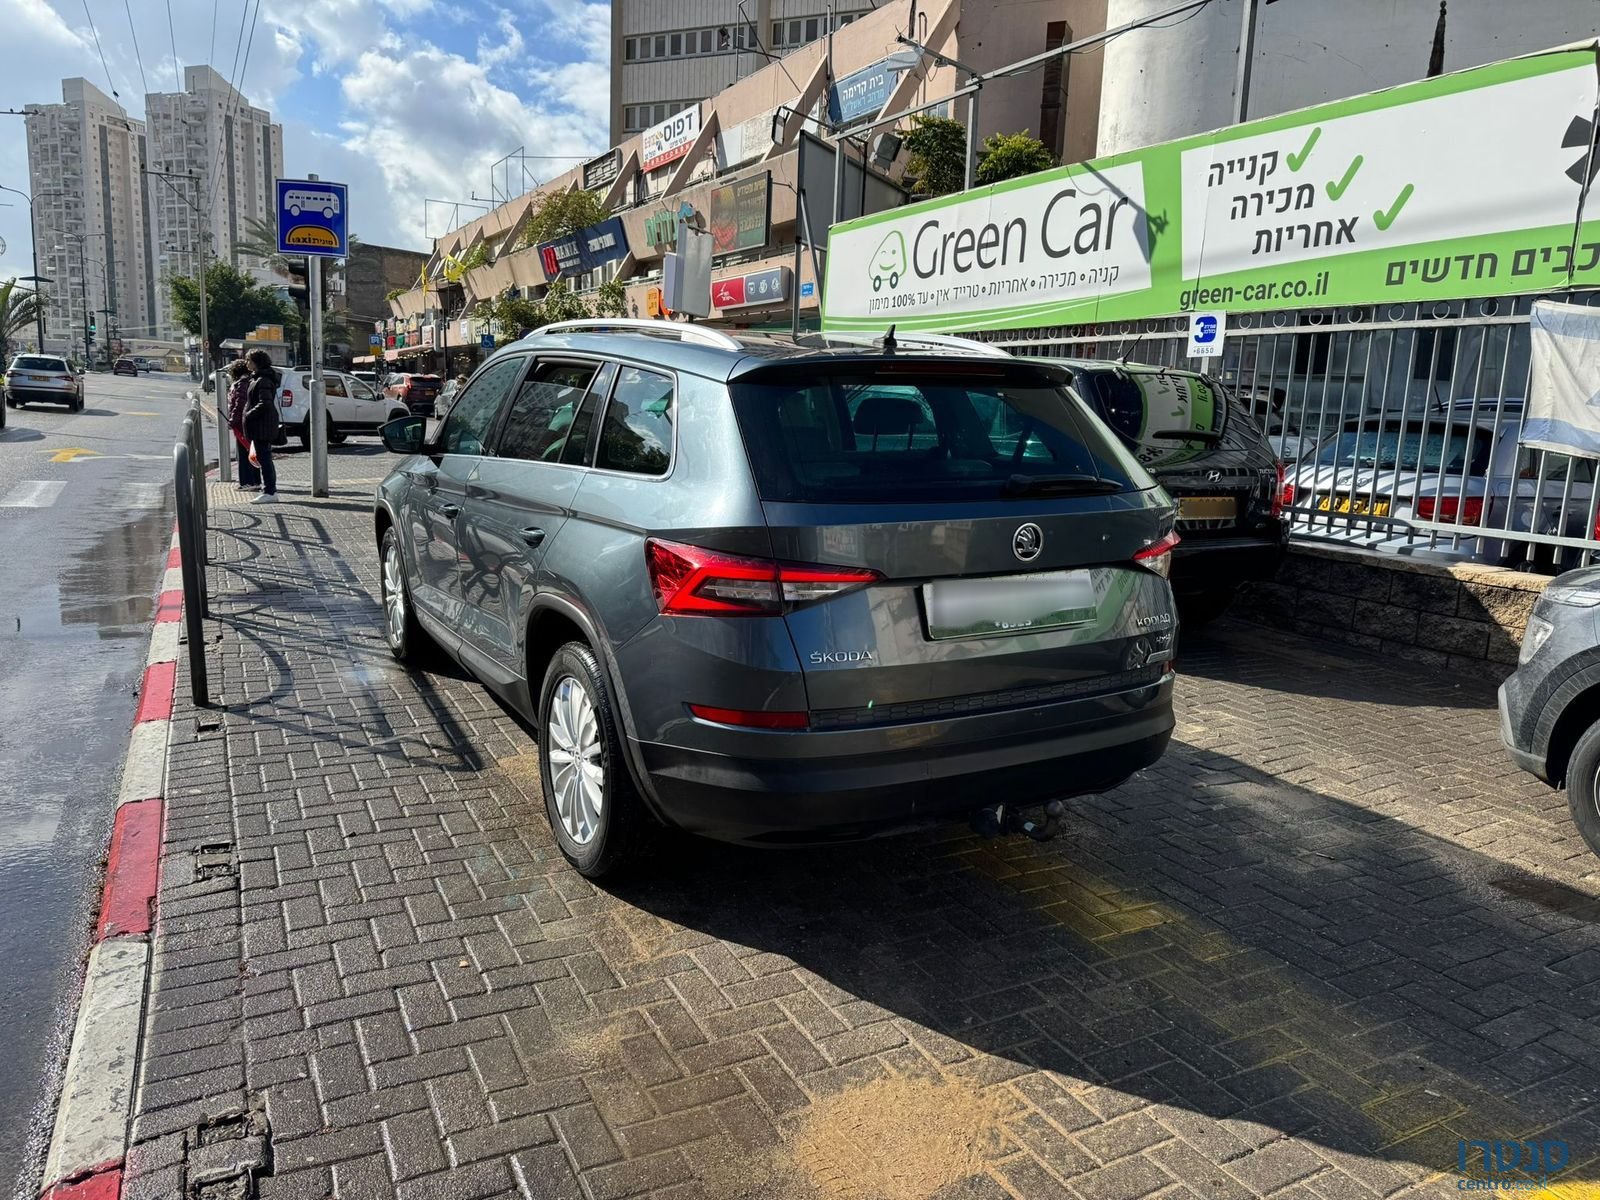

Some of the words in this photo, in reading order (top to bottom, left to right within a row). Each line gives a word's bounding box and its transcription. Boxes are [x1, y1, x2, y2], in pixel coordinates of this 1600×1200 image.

[842, 80, 867, 102] קדימה
[869, 74, 884, 90] בית
[663, 112, 693, 142] דפוס
[1207, 150, 1279, 187] קנייה
[1230, 183, 1315, 220] מכירה
[292, 233, 311, 243] taxi
[913, 217, 1027, 279] Green
[1041, 188, 1129, 259] Car
[1251, 216, 1360, 255] אחריות
[1088, 264, 1120, 284] קניה
[1385, 252, 1499, 286] חדשים
[987, 277, 1029, 296] אחריות
[1038, 271, 1077, 291] מכירה
[1179, 271, 1330, 311] green-car.co.il
[891, 292, 916, 309] 100%
[917, 292, 929, 307] עד
[935, 287, 950, 307] אין
[953, 283, 980, 300] טרייד
[868, 296, 890, 314] מימון
[809, 650, 873, 664] ŠKODA
